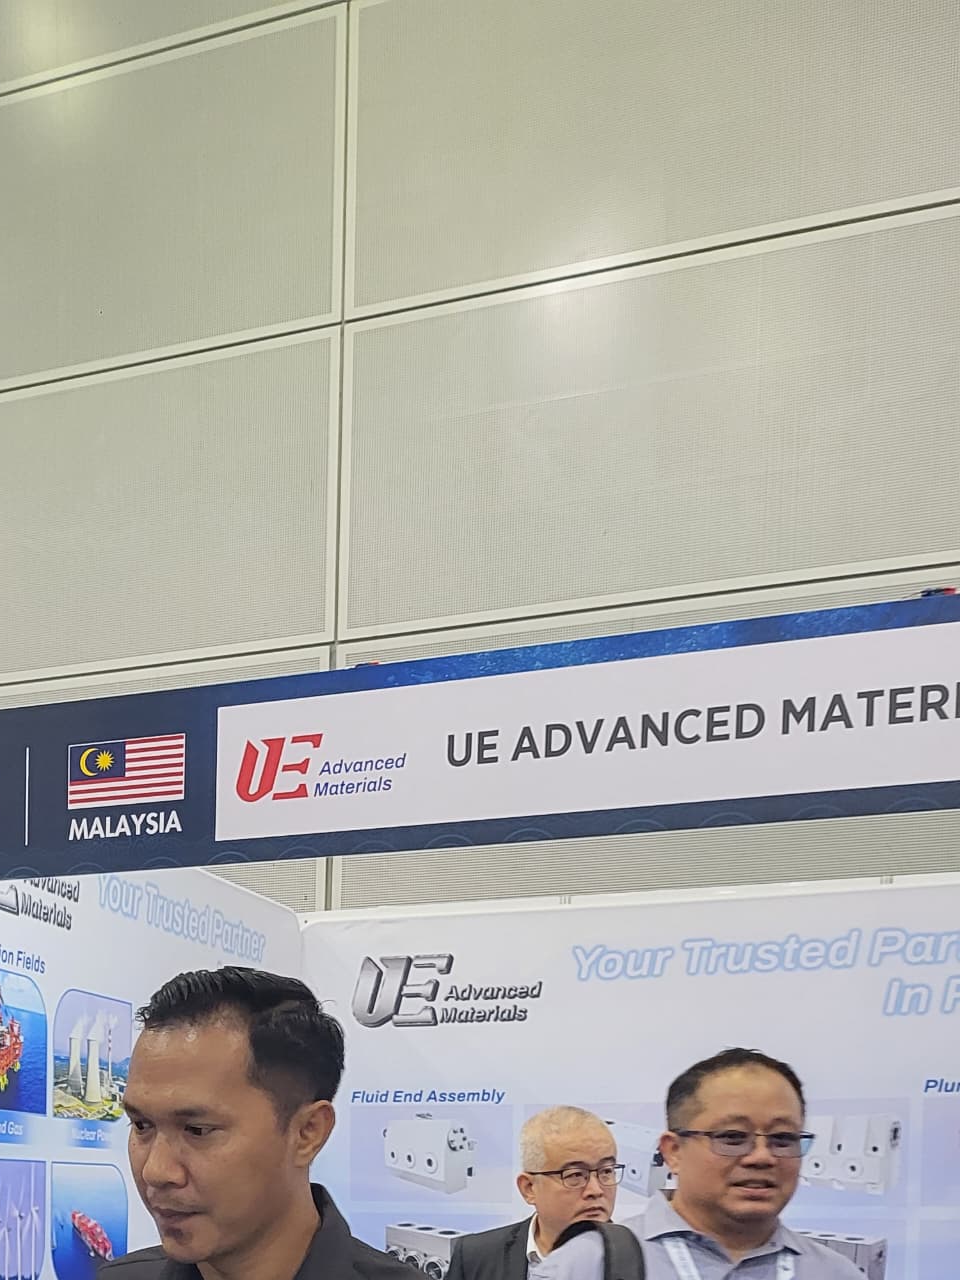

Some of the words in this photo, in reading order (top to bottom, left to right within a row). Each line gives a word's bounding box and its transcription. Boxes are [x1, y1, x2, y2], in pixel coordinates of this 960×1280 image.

[447, 731, 499, 768] UE
[512, 702, 765, 763] ADVANCED
[236, 732, 324, 803] UE
[319, 752, 407, 776] Advanced
[314, 776, 393, 798] Materials
[68, 810, 183, 842] MALAYSIA
[20, 892, 73, 931] Materials
[98, 874, 143, 920] Your
[145, 882, 211, 945] Trusted
[211, 908, 266, 962] Partner
[16, 950, 46, 975] Fields
[572, 945, 674, 981] Your
[682, 928, 862, 975] Trusted
[352, 953, 455, 1029] UE
[444, 980, 543, 1002] Advanced
[882, 977, 933, 1017] In
[440, 1004, 529, 1024] Materials
[351, 1090, 390, 1103] Fluid
[392, 1089, 425, 1103] End
[426, 1088, 507, 1105] Assembly
[7, 1121, 24, 1136] Gas
